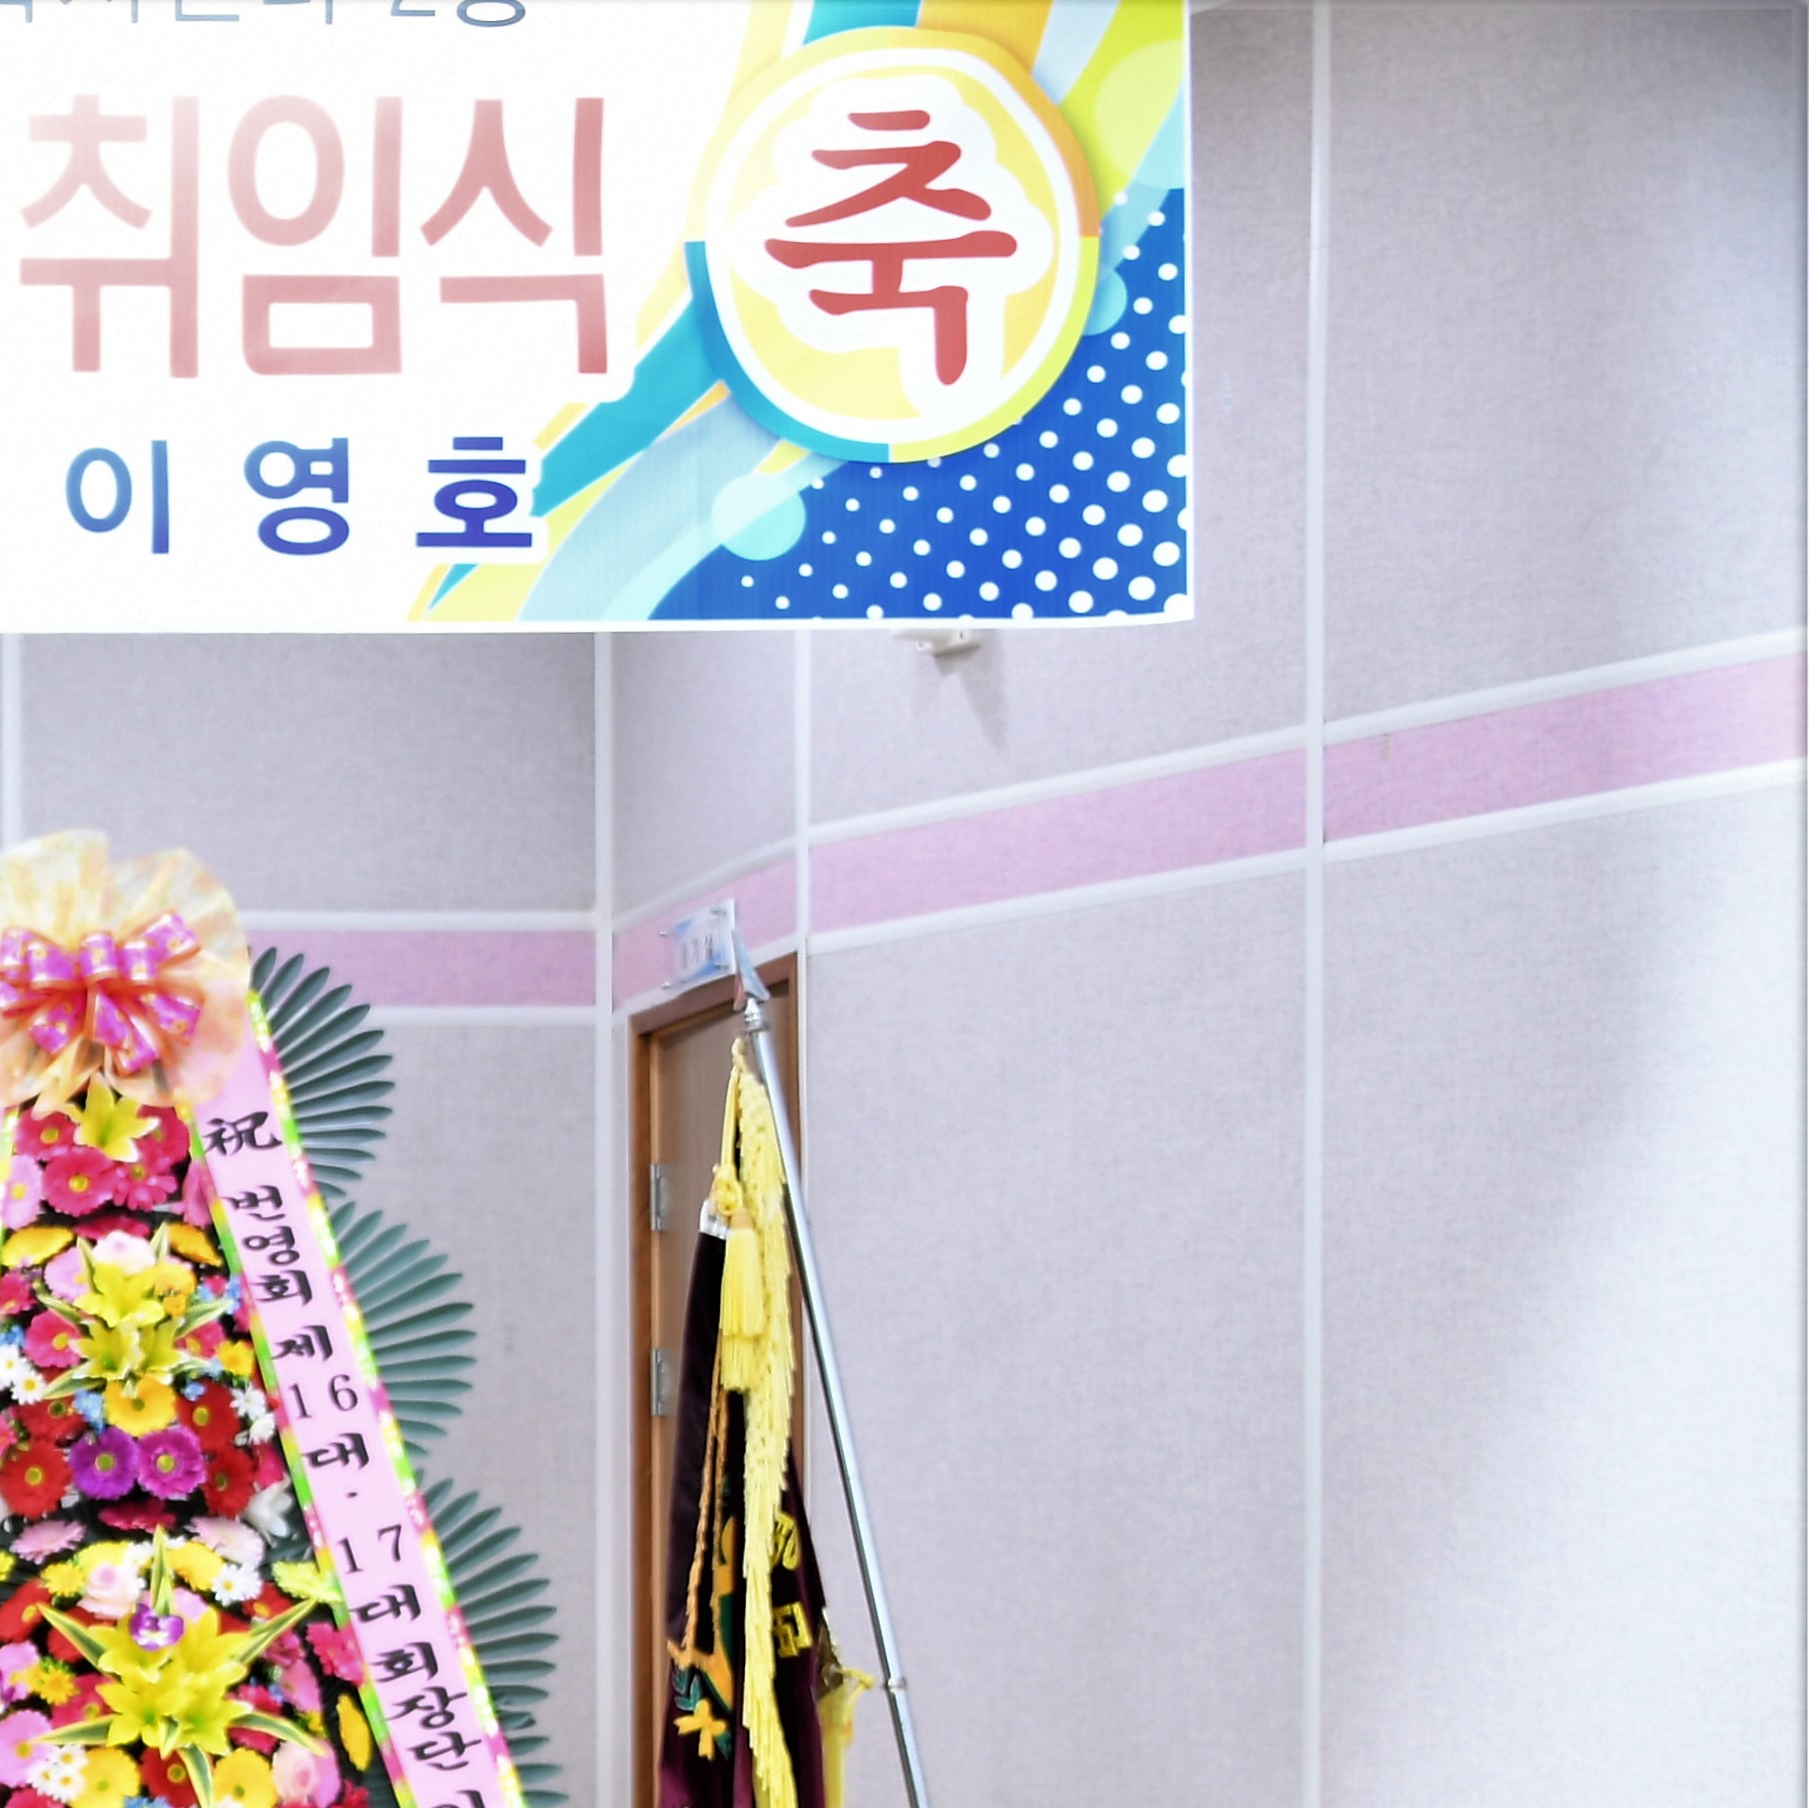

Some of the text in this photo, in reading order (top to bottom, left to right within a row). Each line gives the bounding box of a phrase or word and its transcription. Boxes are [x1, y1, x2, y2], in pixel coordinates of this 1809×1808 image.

[765, 108, 1017, 386] 축
[203, 1110, 284, 1157] 祝
[223, 1183, 314, 1307] 번영회
[372, 1640, 484, 1772] 회장단
